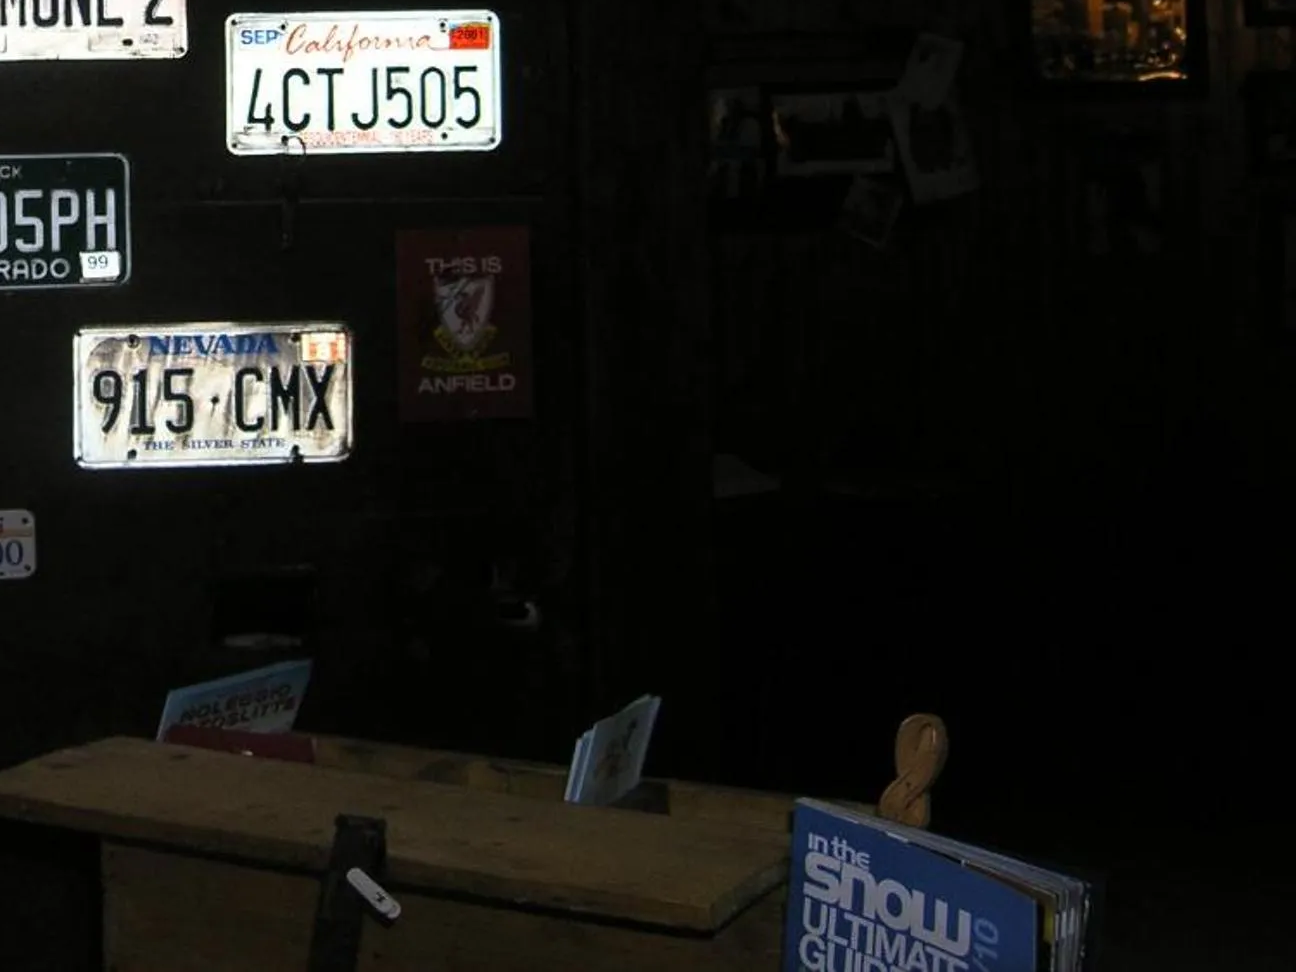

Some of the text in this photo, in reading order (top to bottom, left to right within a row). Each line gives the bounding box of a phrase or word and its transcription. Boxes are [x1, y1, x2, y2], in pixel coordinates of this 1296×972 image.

[240, 29, 278, 46] SEP
[285, 23, 436, 63] California
[247, 65, 482, 132] 4CTJ505
[87, 255, 109, 270] 99
[424, 255, 503, 275] THIS IS
[148, 333, 279, 356] NEVADA
[418, 372, 517, 395] ANFIELD
[143, 436, 286, 452] THE SILVER STATE
